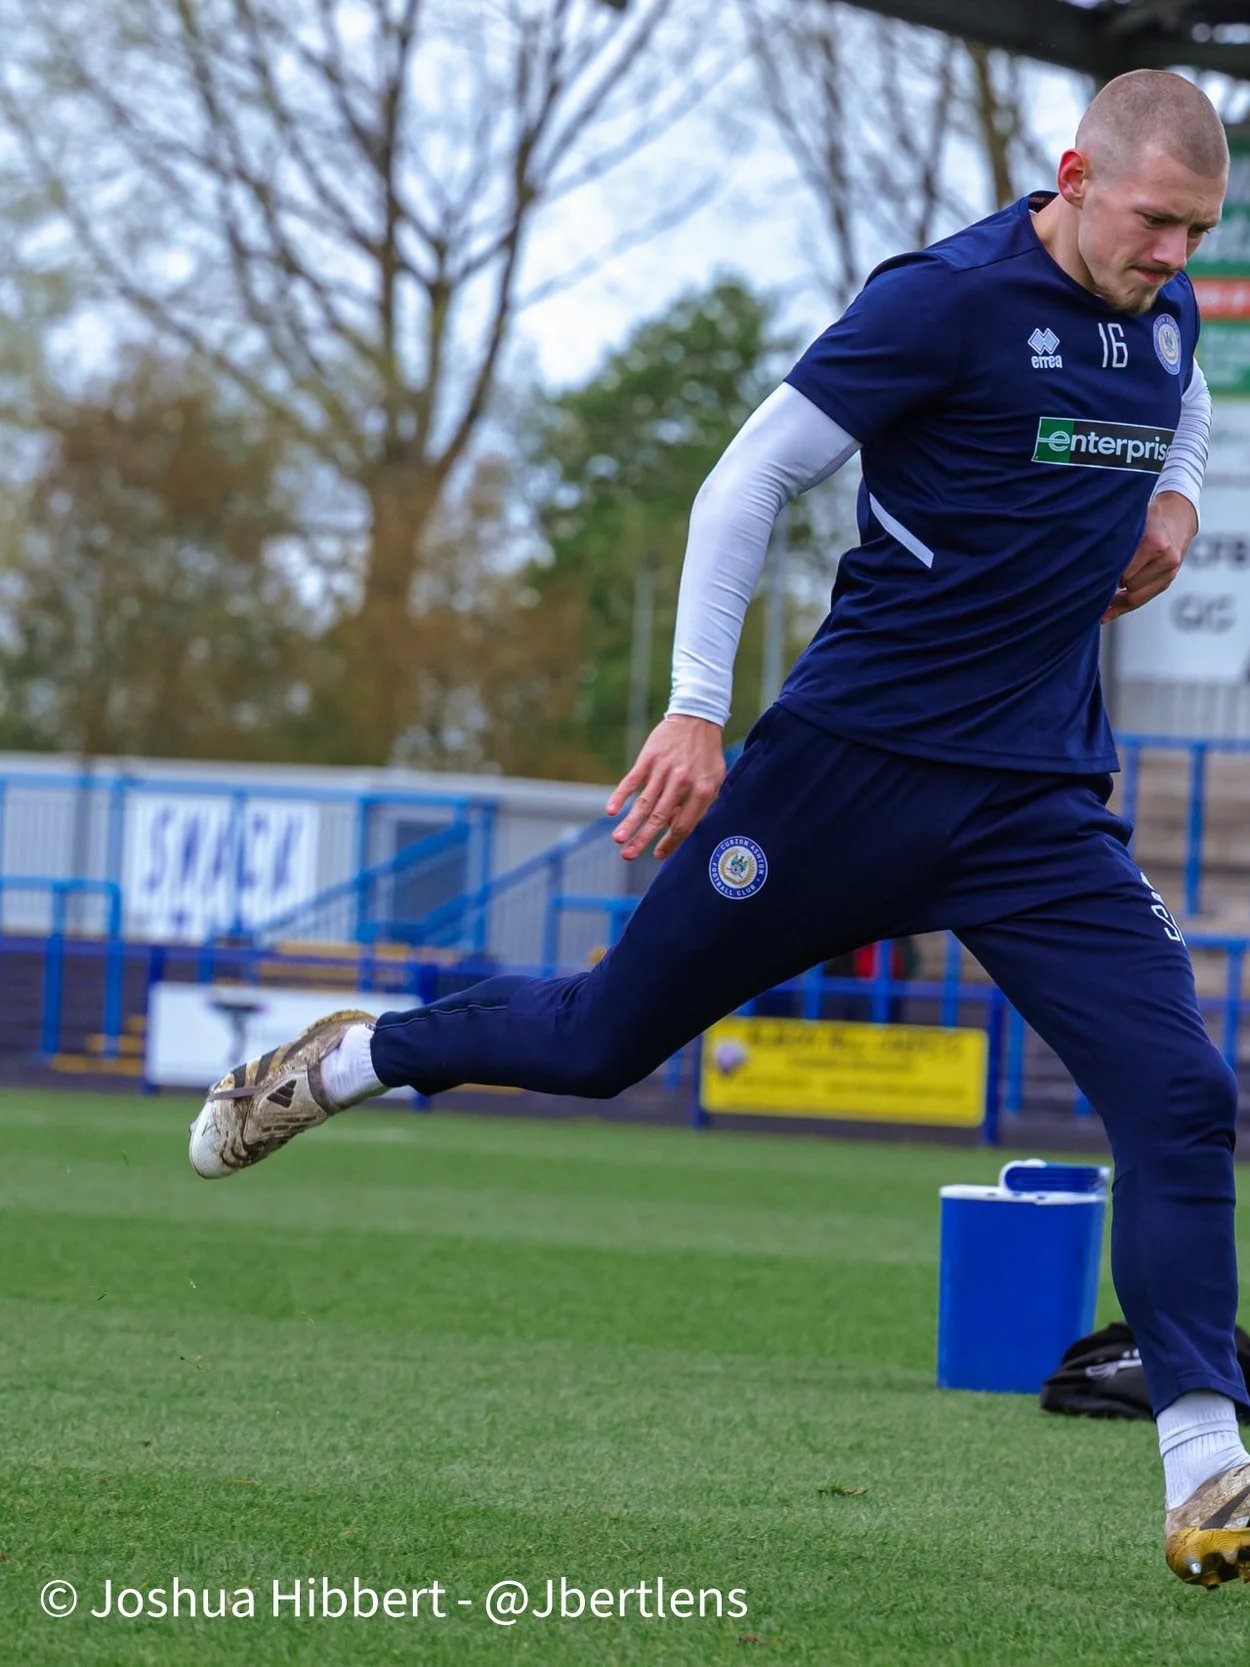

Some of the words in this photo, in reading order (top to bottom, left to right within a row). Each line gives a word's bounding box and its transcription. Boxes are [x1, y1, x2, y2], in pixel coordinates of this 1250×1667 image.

[1097, 322, 1129, 368] 16
[1030, 354, 1063, 369] errea
[736, 884, 756, 897] CLUB
